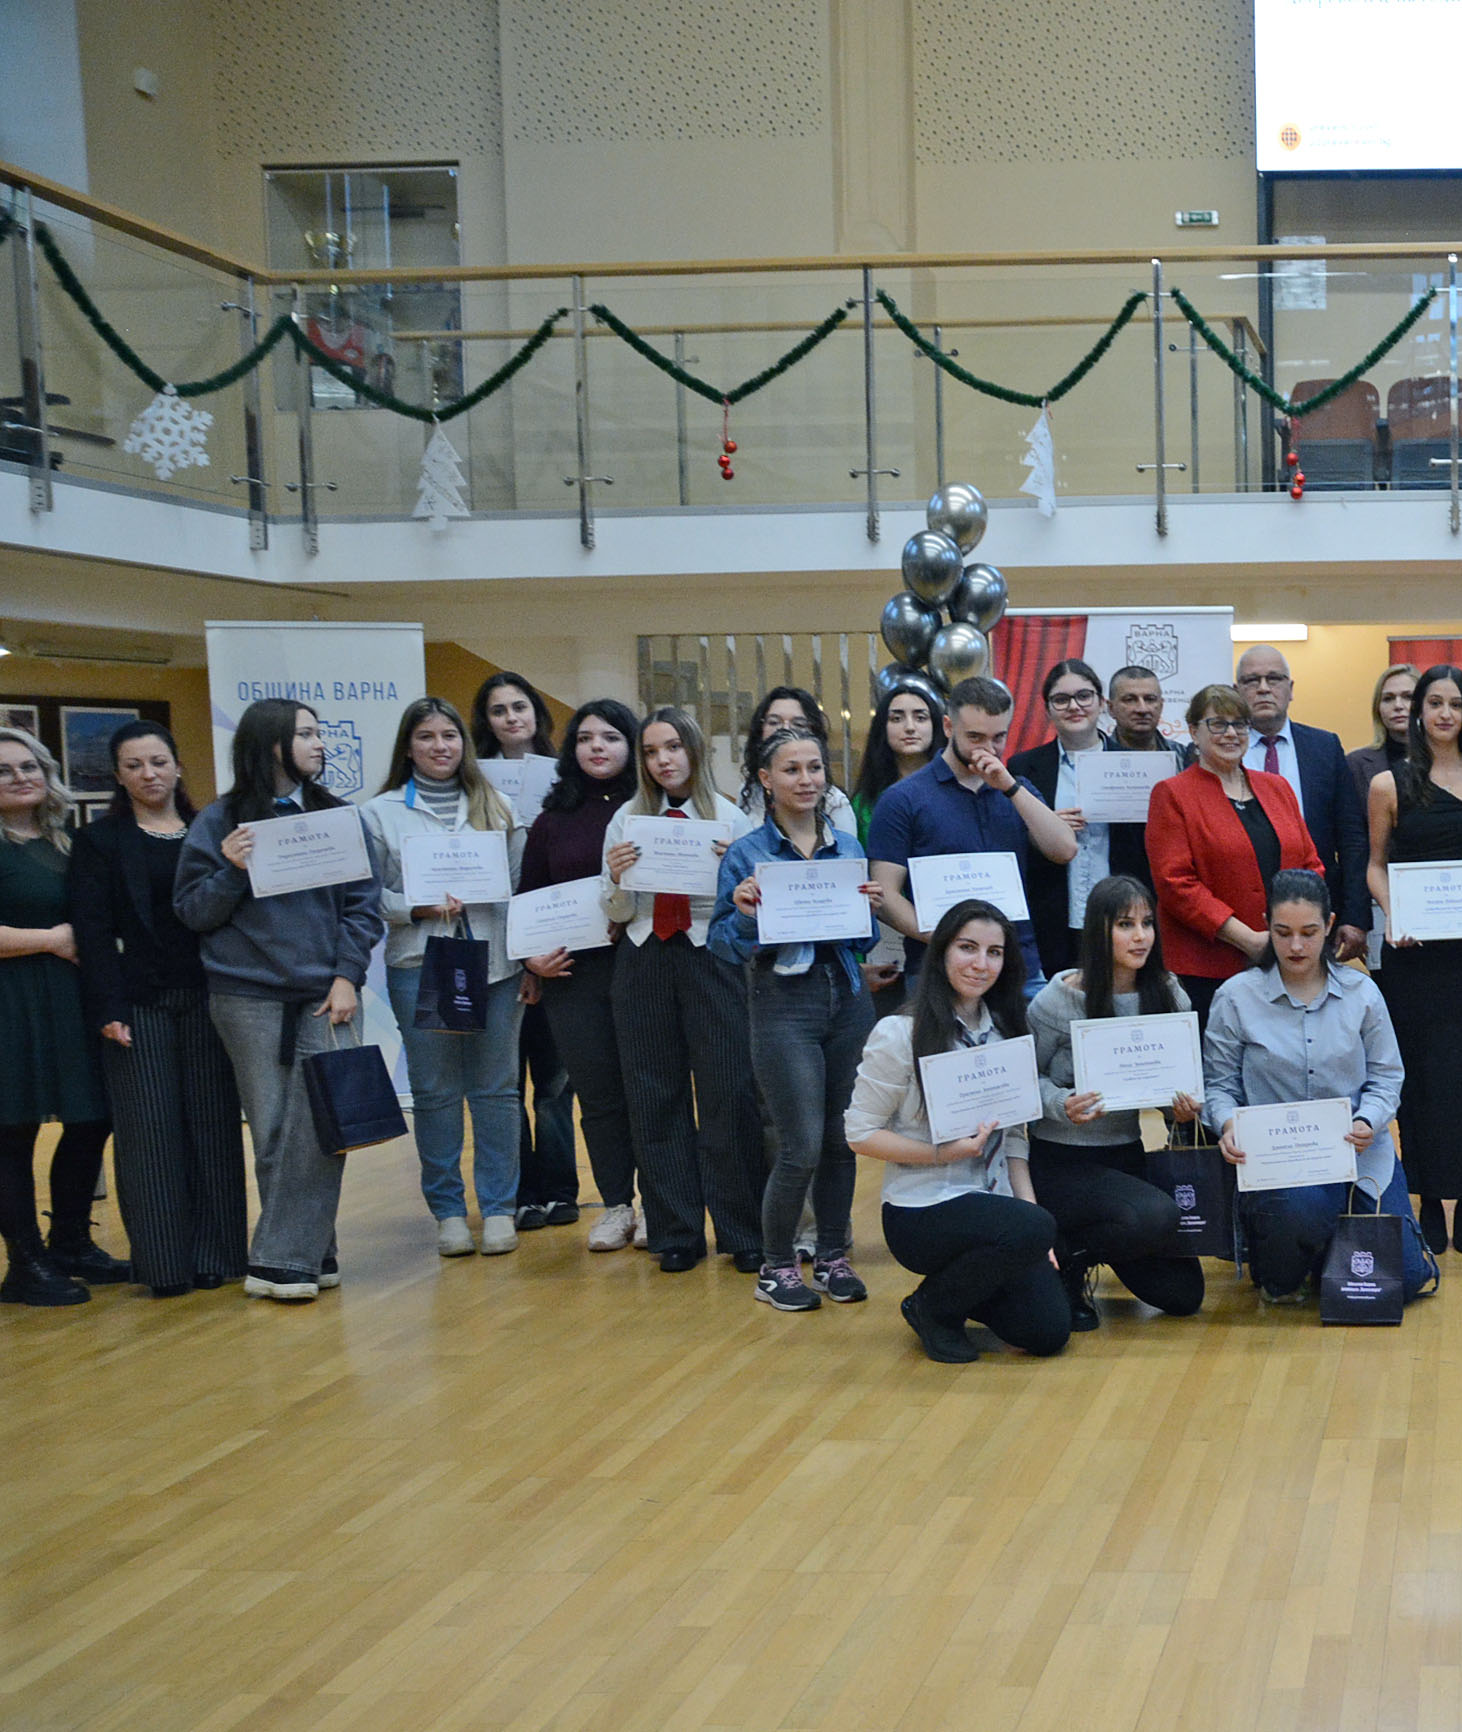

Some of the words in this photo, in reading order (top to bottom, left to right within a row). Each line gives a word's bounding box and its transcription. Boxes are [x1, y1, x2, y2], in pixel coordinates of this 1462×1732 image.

[1133, 629, 1171, 637] ВАРНА
[237, 681, 326, 702] ОБЩИНА
[333, 681, 399, 701] ВАРНА
[277, 831, 331, 847] ГРАМОТА
[654, 837, 703, 847] ГРАМОТА
[787, 881, 837, 892] ГРАМОТА
[1112, 1042, 1166, 1055] ГРАМОТА
[956, 1065, 1008, 1083] ГРАМОТА
[1268, 1124, 1321, 1137] ГРАМОТА
